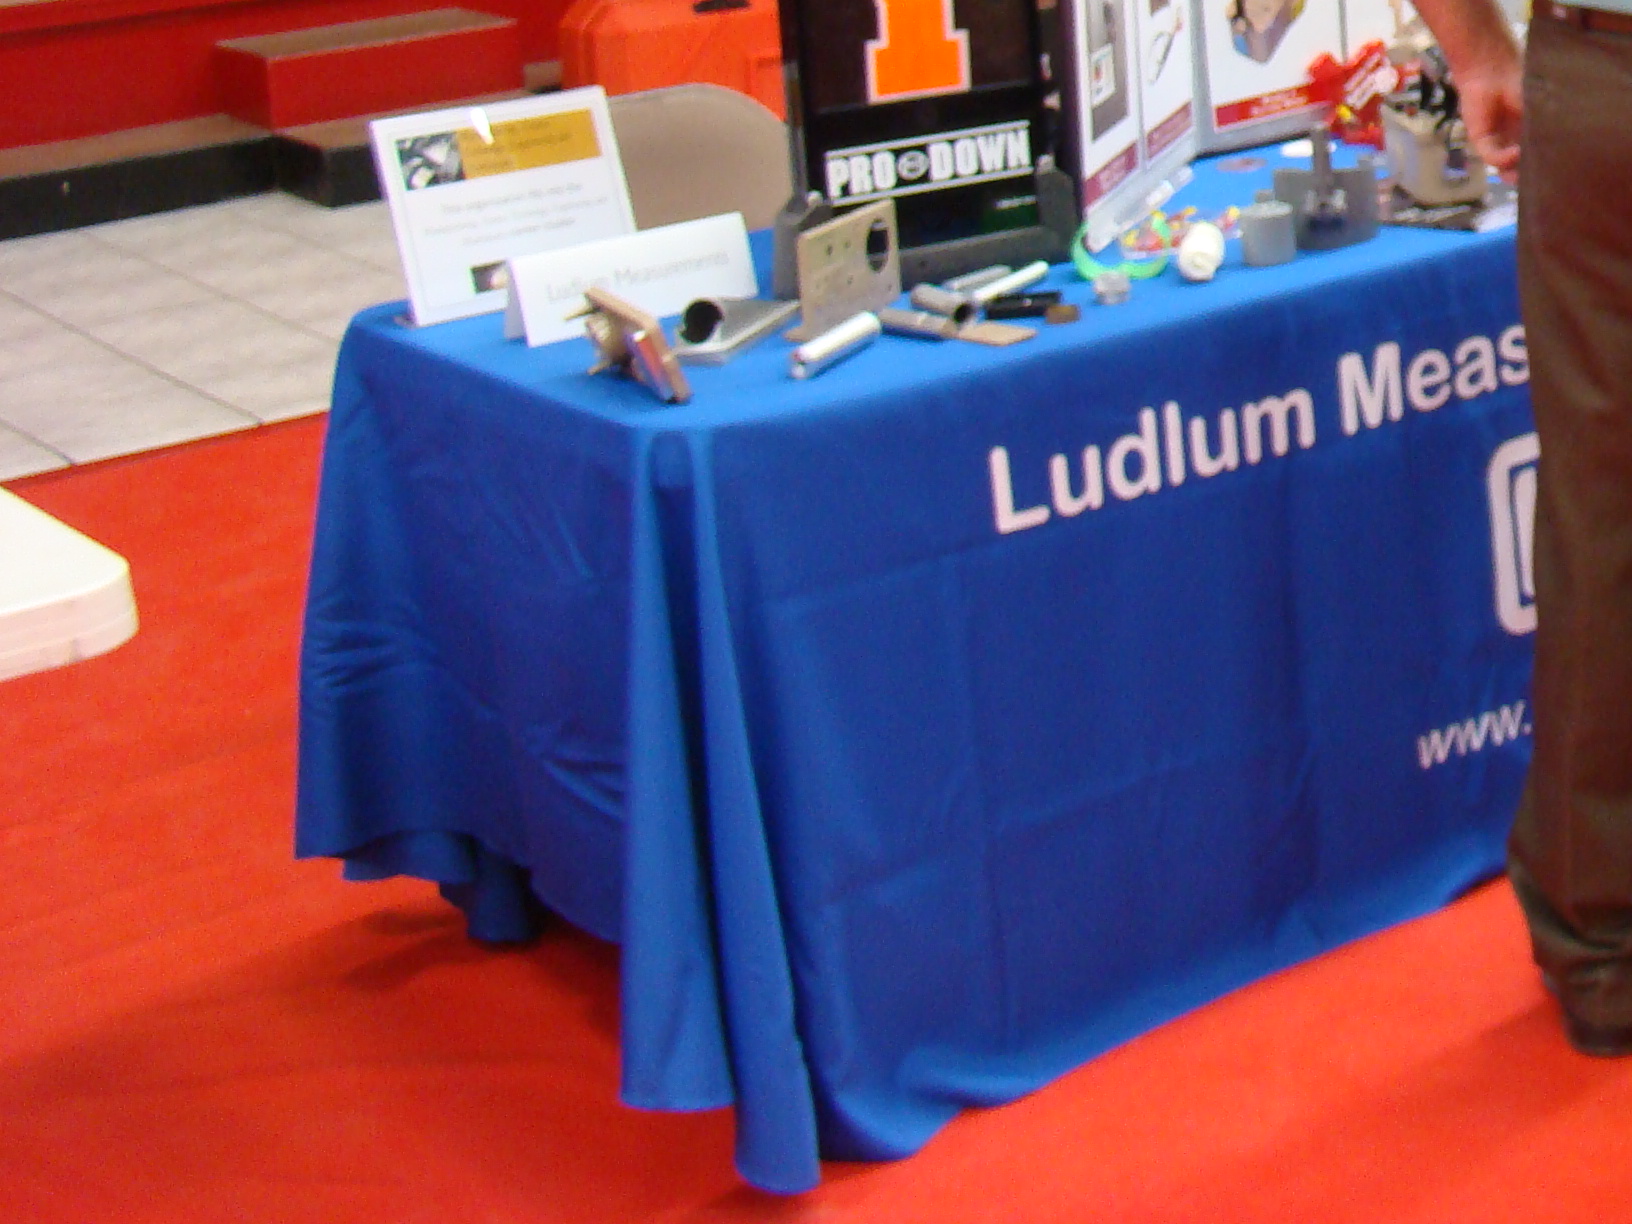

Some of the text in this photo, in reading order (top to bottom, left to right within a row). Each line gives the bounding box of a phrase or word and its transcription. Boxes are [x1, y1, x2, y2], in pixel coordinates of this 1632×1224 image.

[825, 128, 1032, 200] PRO DOWN
[989, 323, 1531, 535] Ludlum Meas
